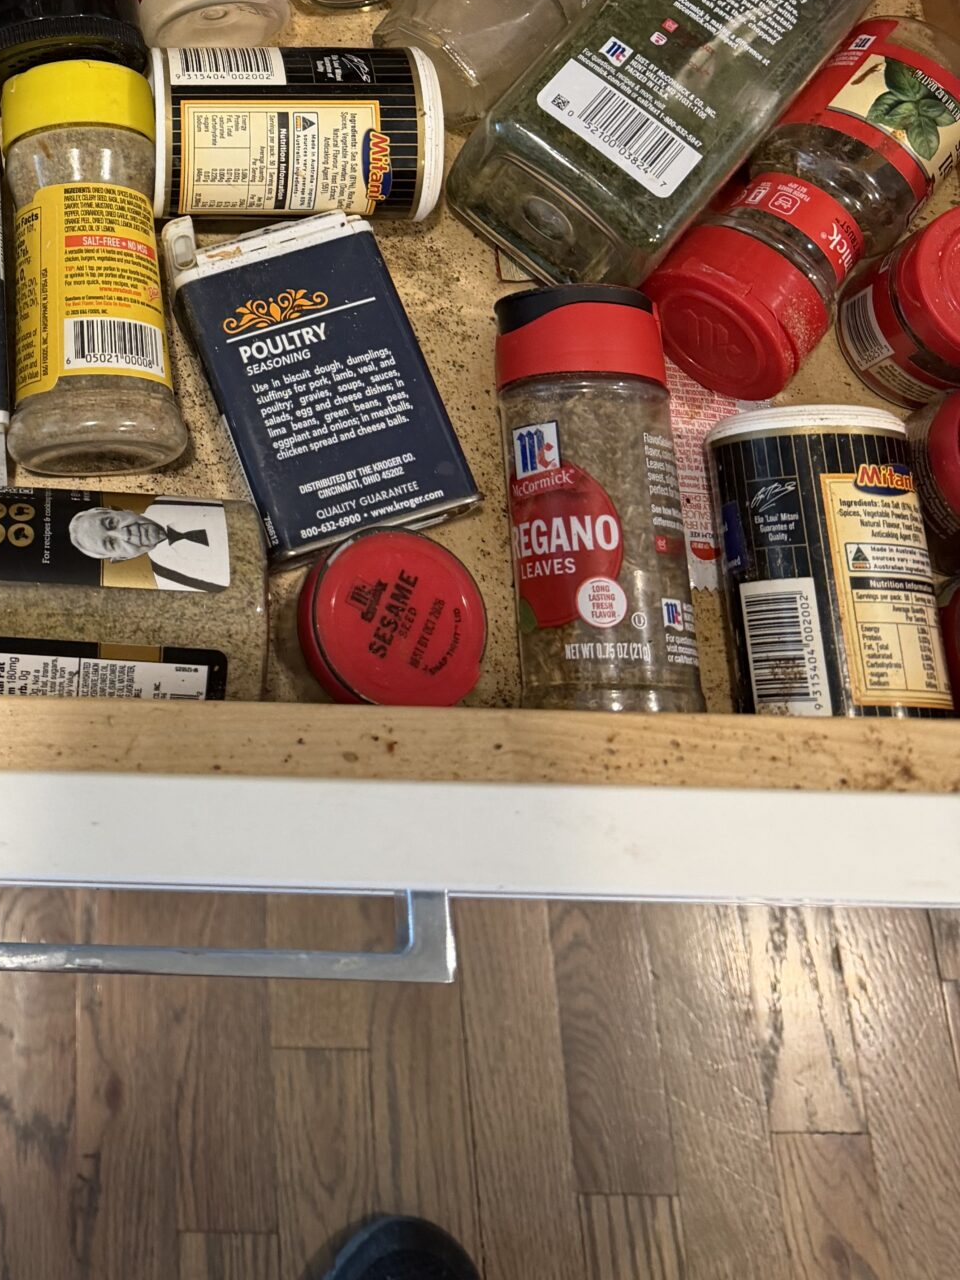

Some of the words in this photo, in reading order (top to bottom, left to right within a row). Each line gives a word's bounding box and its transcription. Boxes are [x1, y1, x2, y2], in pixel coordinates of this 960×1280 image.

[279, 128, 287, 162] Nutrition
[277, 164, 287, 200] Information
[369, 132, 390, 200] Mitani
[239, 322, 326, 363] POULTRY
[85, 354, 120, 363] 05021
[125, 354, 152, 368] 00008
[246, 349, 311, 376] SEASONING
[252, 383, 269, 394] Use
[272, 379, 281, 387] in
[283, 370, 311, 384] biscuit
[314, 361, 343, 375] dough,
[347, 347, 391, 365] dumplings,
[256, 387, 292, 405] stuffings
[294, 384, 307, 393] for
[309, 378, 331, 390] pork,
[332, 369, 356, 382] lamb,
[358, 362, 378, 374] veal,
[380, 358, 396, 368] and
[260, 400, 294, 418] poultry;
[300, 391, 332, 406] gravies,
[338, 381, 364, 394] soups,
[370, 369, 400, 382] sauces,
[277, 446, 308, 460] chicken
[310, 437, 338, 451] spread
[340, 430, 356, 441] and
[357, 422, 386, 436] cheese
[388, 414, 409, 427] balls.
[299, 474, 345, 494] DISTRIBUTED
[347, 471, 357, 479] BY
[359, 466, 371, 476] THE
[373, 457, 401, 472] KROGER
[403, 453, 415, 464] CO.
[318, 481, 362, 499] CINCINNATI,
[364, 476, 380, 486] OHIO
[382, 467, 405, 479] 45202
[512, 471, 575, 496] McCormick
[301, 514, 361, 539] 800-632-6900
[371, 490, 444, 517] www.kroger.com
[316, 500, 356, 519] QUALITY
[360, 481, 419, 506] GUARANTEE
[521, 558, 576, 579] LEAVES
[589, 593, 615, 601] LASTING
[592, 585, 610, 593] LONG
[368, 569, 418, 658] SESAME
[399, 607, 416, 639] SEED
[565, 643, 580, 659] NET
[581, 644, 594, 660] WT
[596, 643, 615, 659] 0.75
[617, 643, 628, 659] OZ
[630, 643, 651, 661] (21g)
